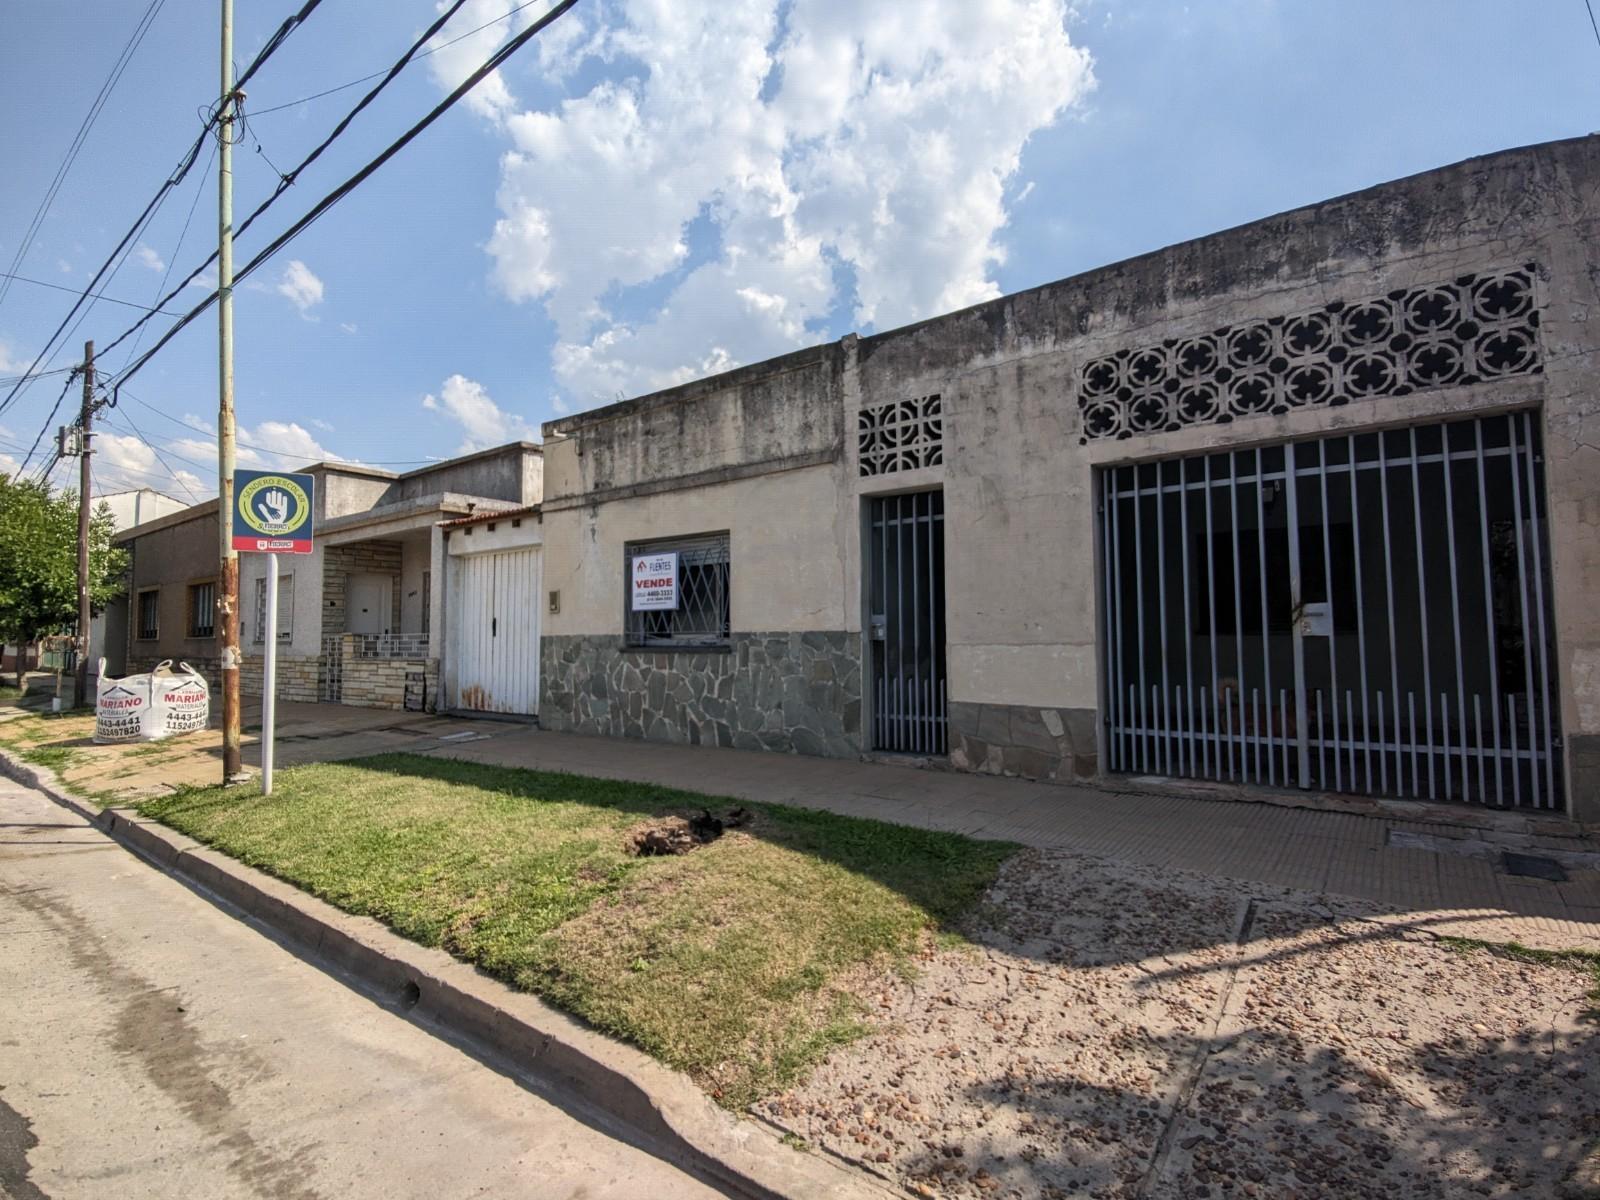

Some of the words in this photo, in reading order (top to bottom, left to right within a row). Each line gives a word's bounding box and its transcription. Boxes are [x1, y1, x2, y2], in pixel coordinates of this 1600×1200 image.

[243, 479, 275, 499] SENDERO
[276, 479, 306, 503] ESCOLAR
[635, 577, 673, 589] VENDE
[100, 697, 143, 709] MARIANO
